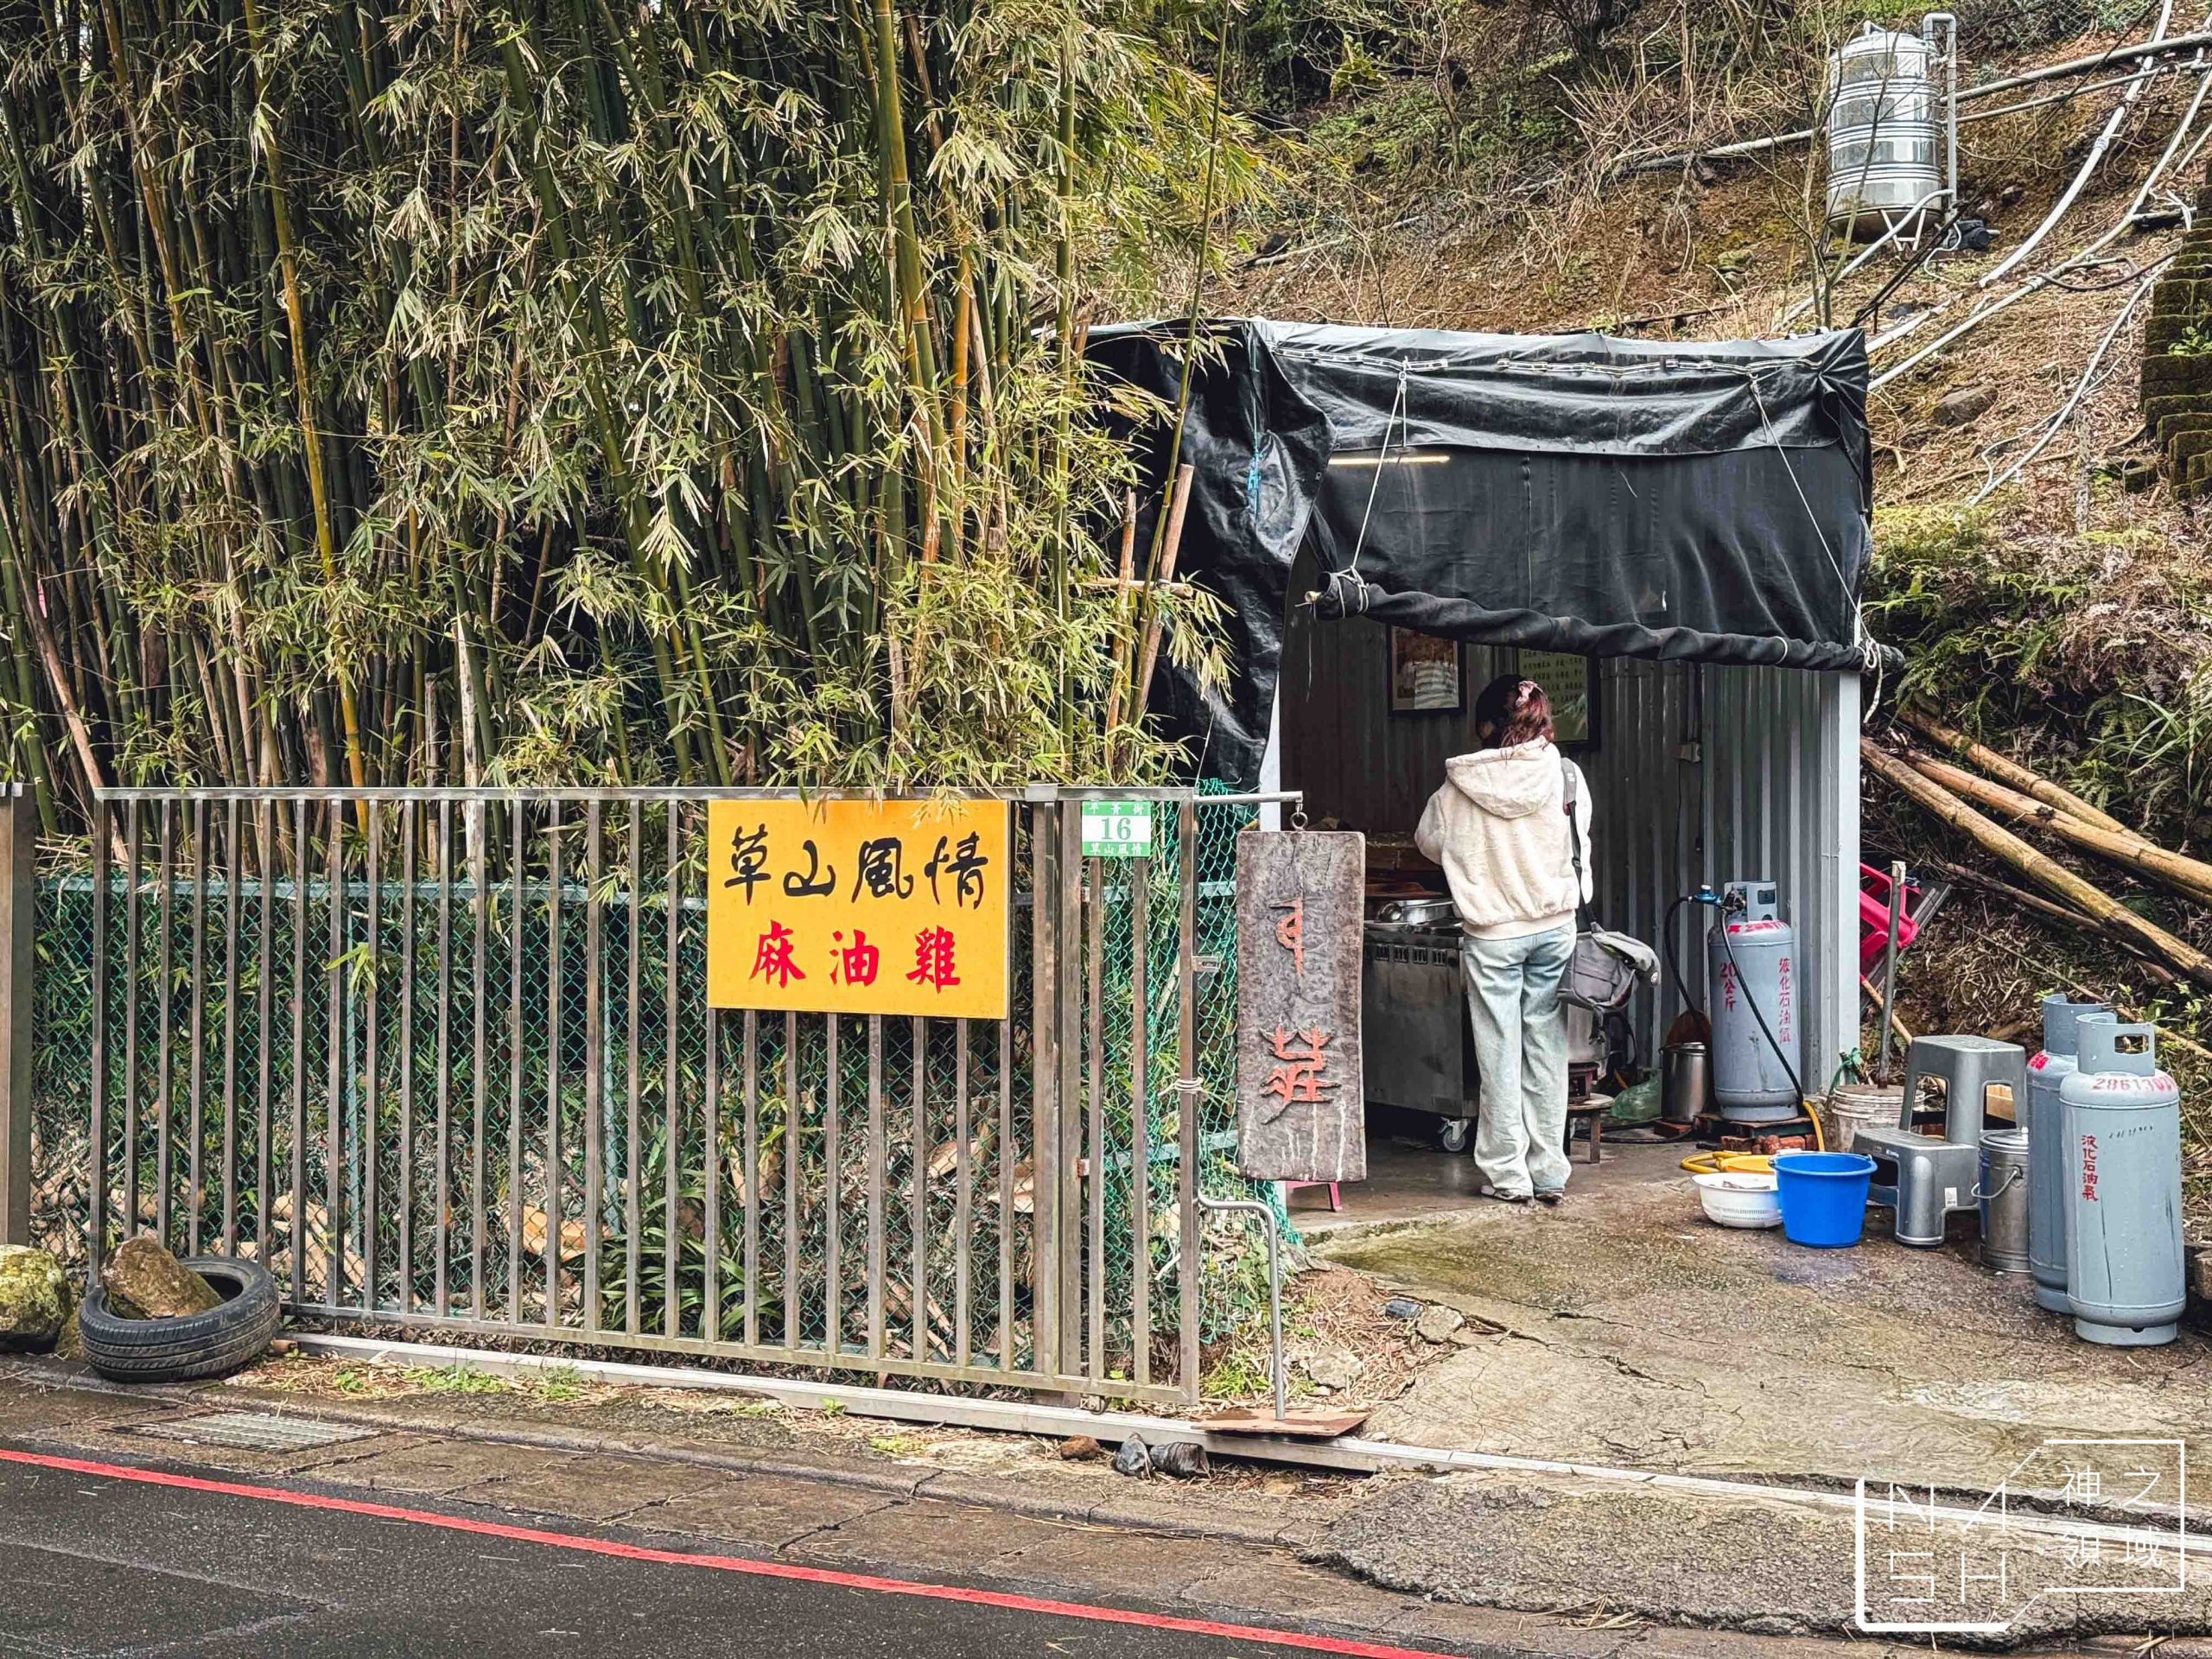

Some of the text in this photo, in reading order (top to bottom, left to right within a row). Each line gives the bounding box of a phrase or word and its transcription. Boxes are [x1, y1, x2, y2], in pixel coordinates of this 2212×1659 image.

[1102, 817, 1131, 840] 16
[724, 823, 988, 909] 草山風情
[749, 919, 961, 994] 麻油雞
[2081, 1135, 2099, 1202] 液化石油氣
